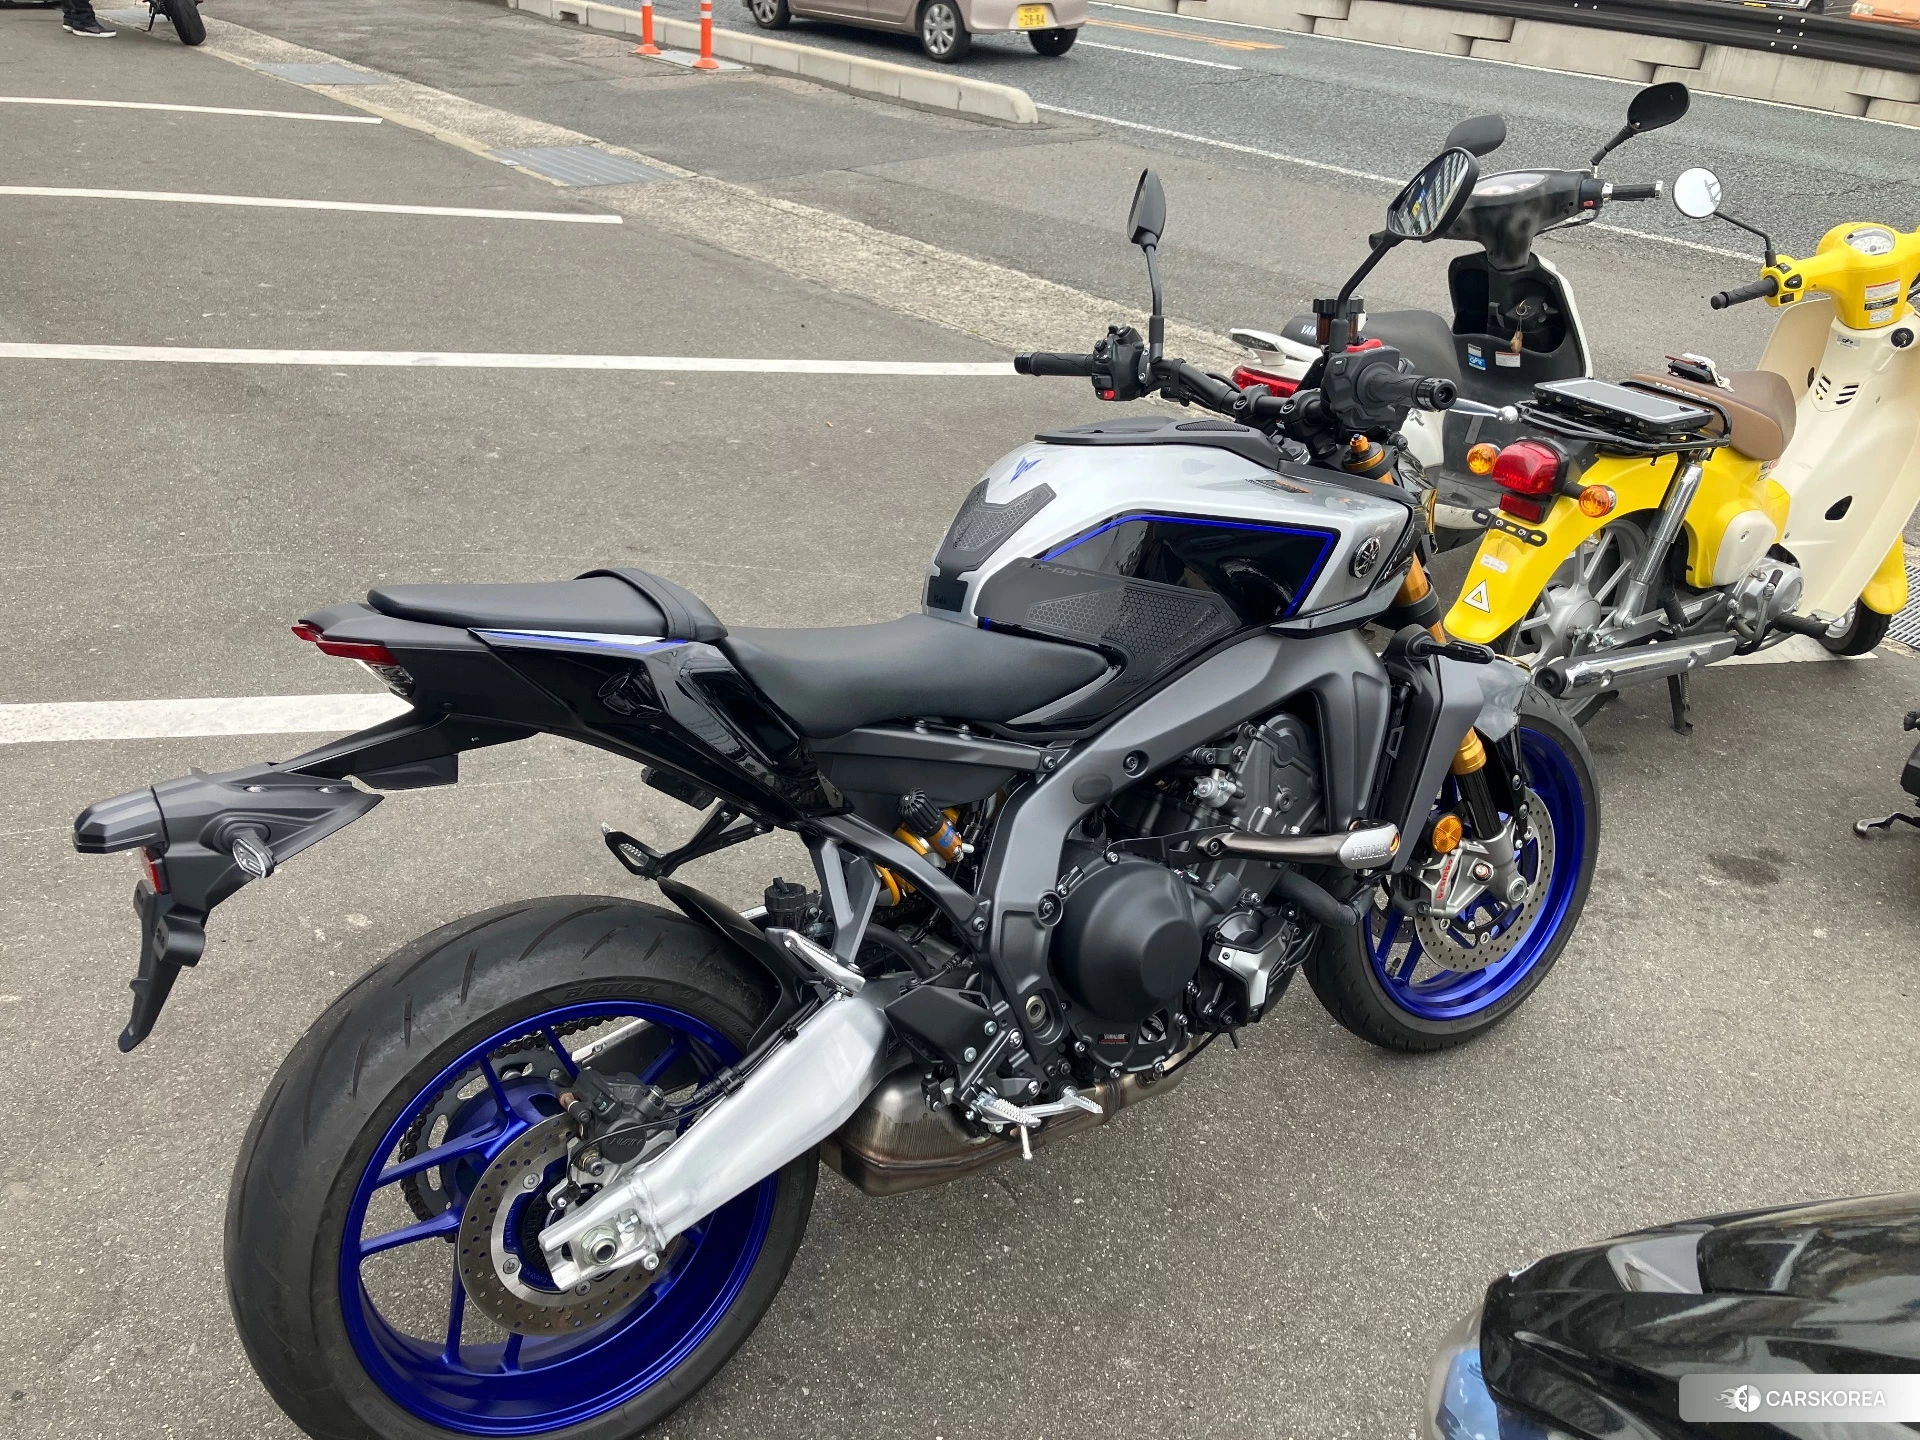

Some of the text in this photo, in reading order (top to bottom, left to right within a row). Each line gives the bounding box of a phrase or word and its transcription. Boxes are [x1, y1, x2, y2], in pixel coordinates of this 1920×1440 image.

[1351, 843, 1388, 860] YAMAHA
[1436, 858, 1452, 900] brembo
[564, 982, 661, 1000] BATTLAX
